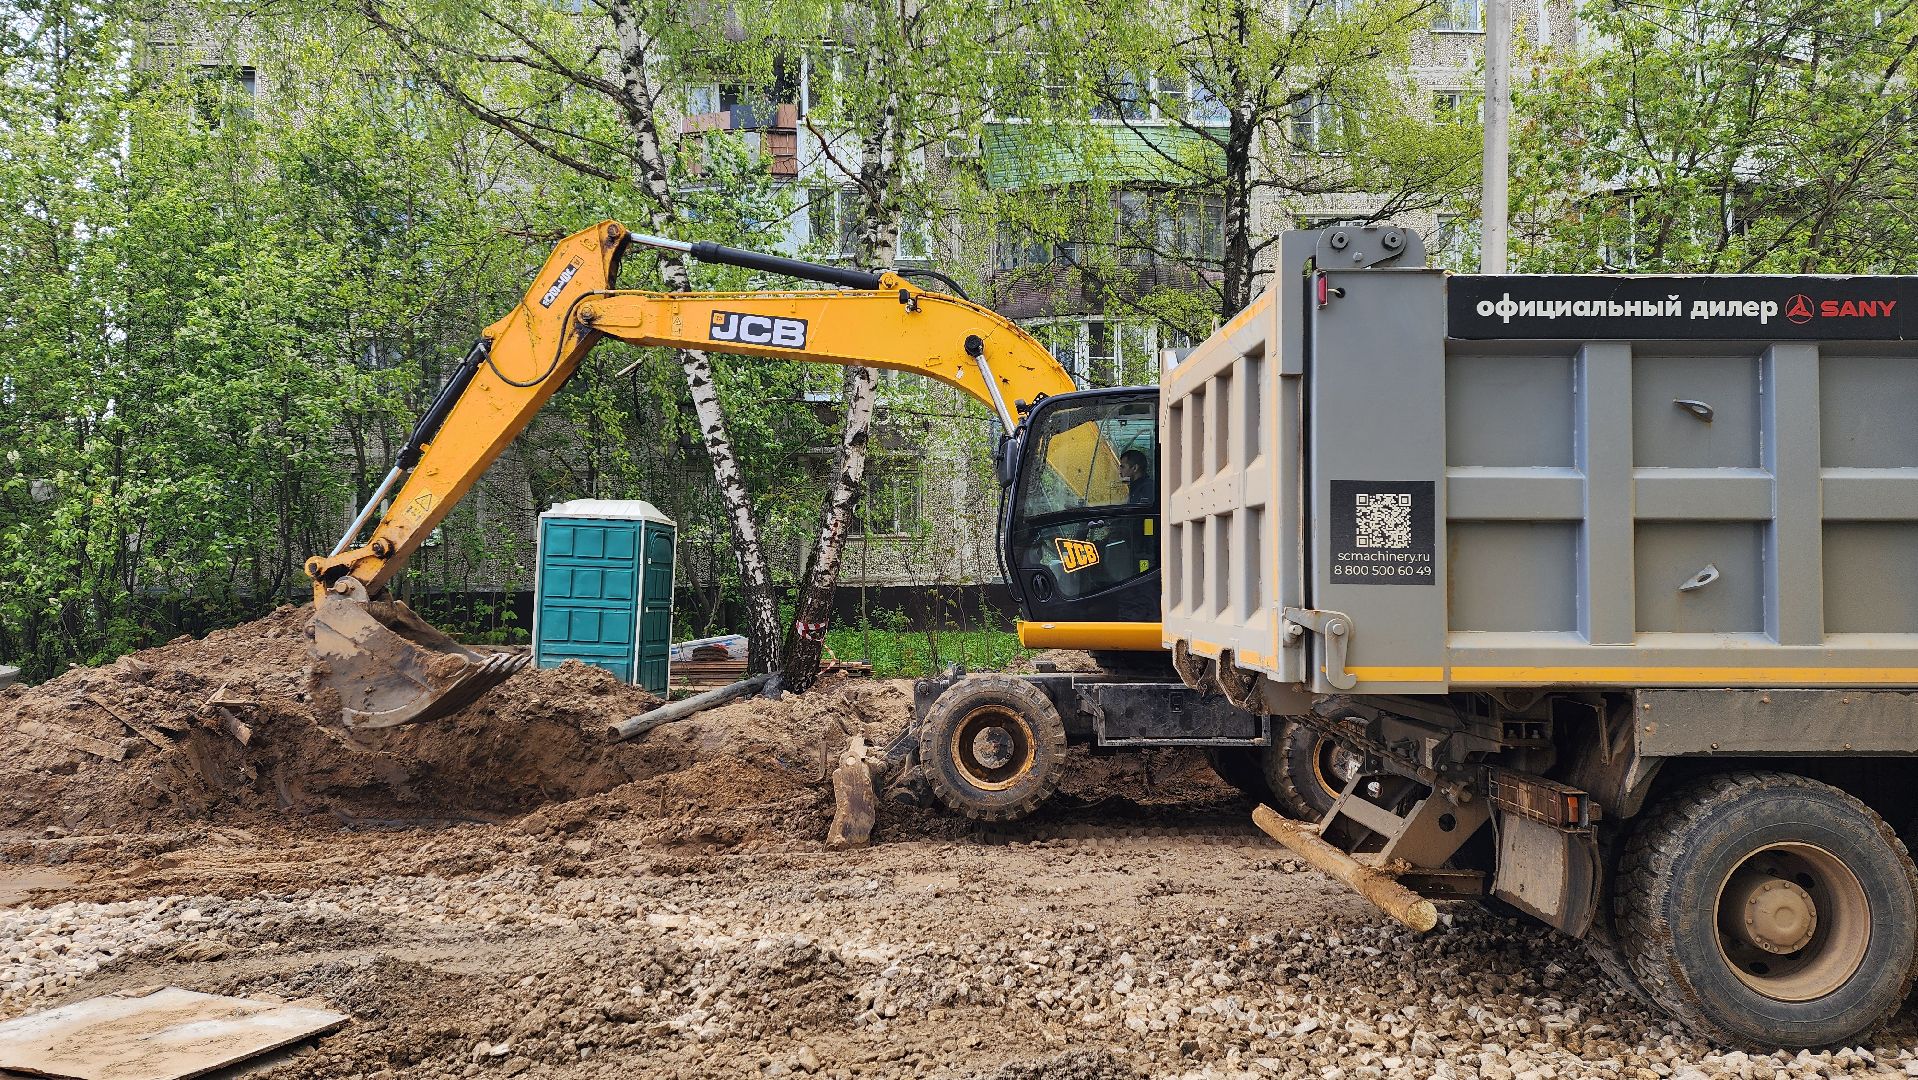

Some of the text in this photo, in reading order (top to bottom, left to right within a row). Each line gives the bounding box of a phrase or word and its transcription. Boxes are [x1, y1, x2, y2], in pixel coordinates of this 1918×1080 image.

[1476, 293, 1778, 324] официальный дилер
[1821, 300, 1896, 317] SANY
[711, 314, 805, 347] JCB
[1063, 541, 1098, 569] JCB
[1337, 550, 1430, 564] scmachinery.ru
[1334, 565, 1432, 576] 8 800 500 60 49
